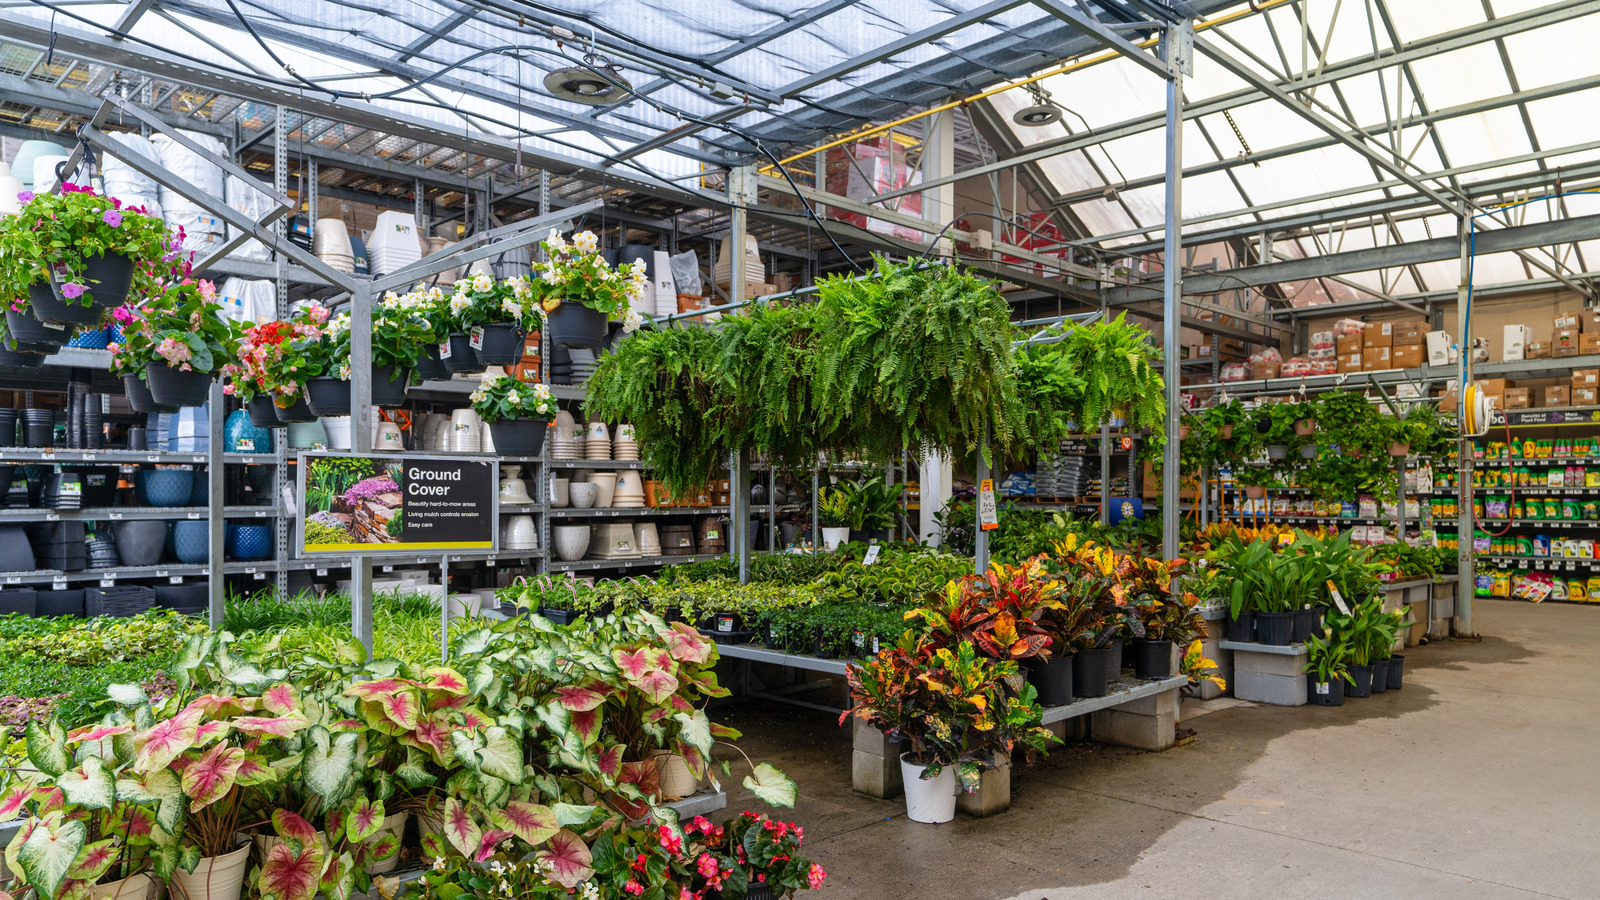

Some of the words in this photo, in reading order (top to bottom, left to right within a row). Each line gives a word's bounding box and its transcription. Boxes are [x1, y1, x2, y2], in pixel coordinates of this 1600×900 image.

[408, 467, 461, 481] Ground
[408, 482, 450, 496] Cover
[408, 500, 429, 508] Beautify
[408, 521, 421, 529] Easy
